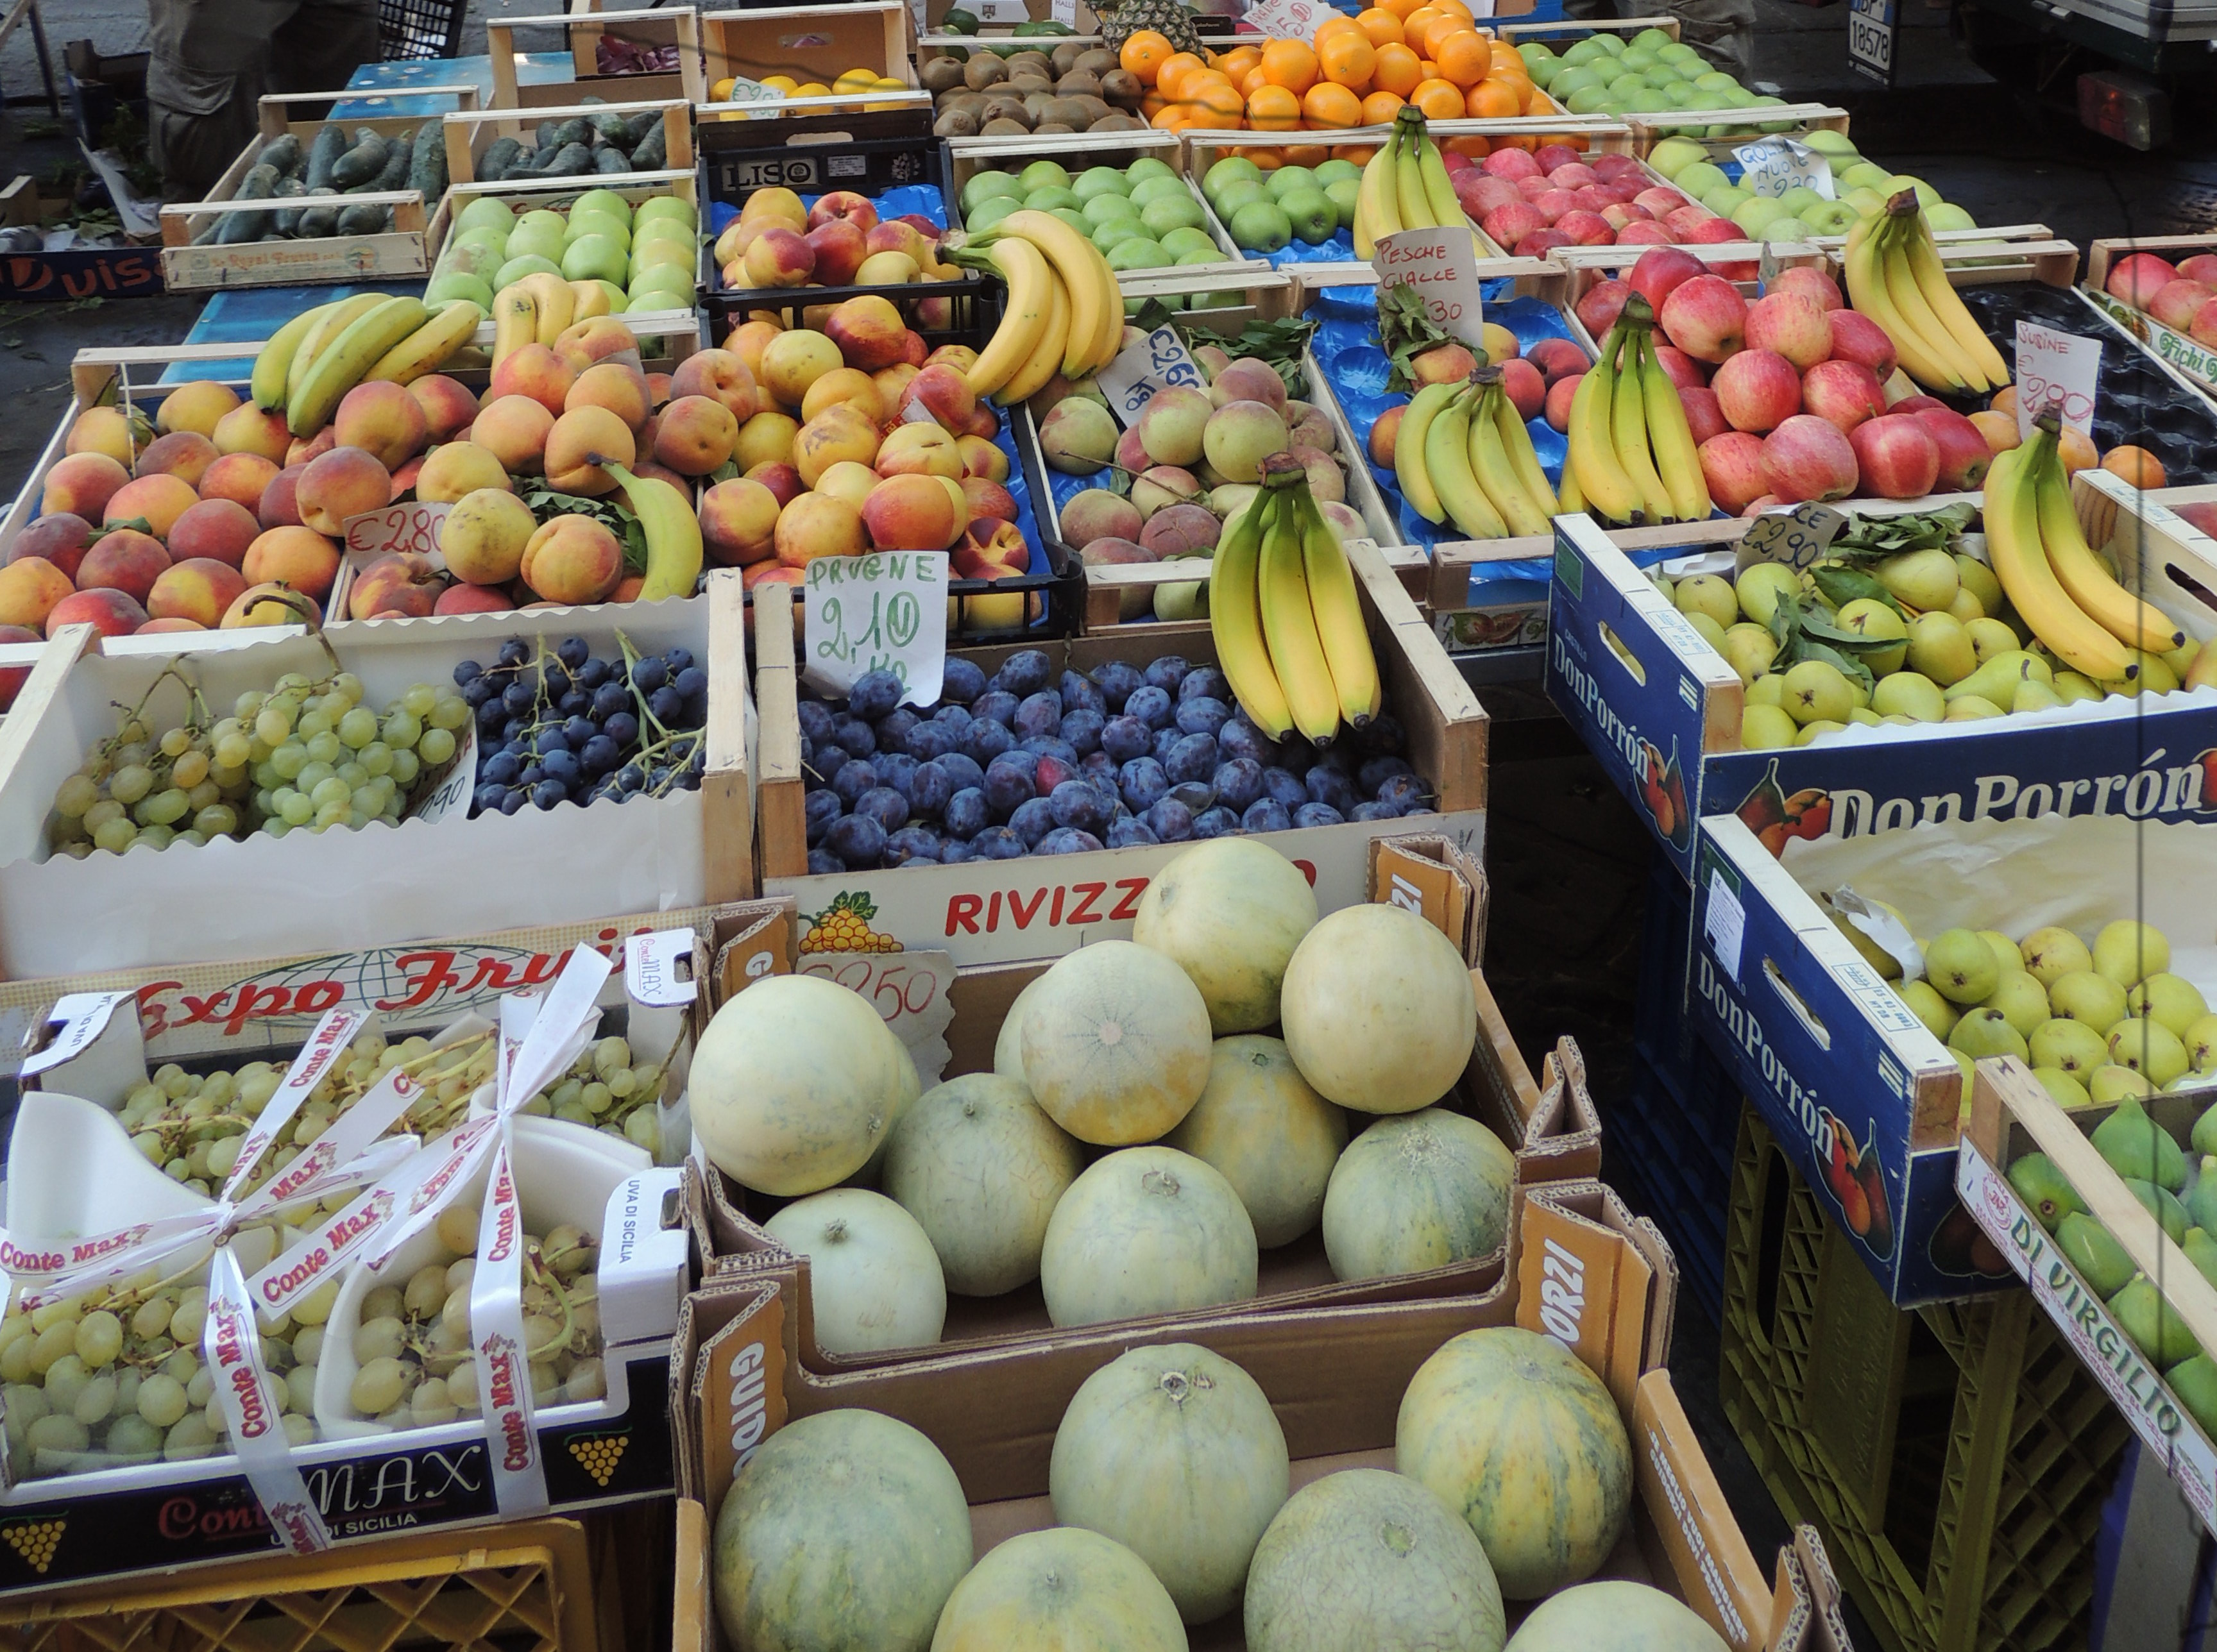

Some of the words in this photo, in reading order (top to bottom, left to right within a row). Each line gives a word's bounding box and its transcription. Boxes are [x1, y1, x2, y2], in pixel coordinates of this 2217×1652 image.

[1853, 20, 1889, 62] 18578
[727, 162, 811, 187] LISO
[1377, 240, 1447, 264] PESCHE
[2017, 354, 2037, 376] €
[1742, 517, 1819, 569] €2,90
[289, 1048, 332, 1088] Conte
[314, 1013, 350, 1045] Max
[269, 1155, 323, 1201] Max
[626, 1179, 640, 1204] UVA
[488, 1206, 514, 1263] Conte
[625, 1206, 638, 1217] DI
[0, 1240, 65, 1271] Conte
[71, 1231, 131, 1263] Max
[263, 1246, 330, 1302] Conte
[325, 1202, 380, 1252] Max
[619, 1220, 636, 1264] SICILIA
[216, 1314, 244, 1368] Max
[2049, 1261, 2182, 1437] VIRGILIO
[232, 1365, 268, 1440] Conte
[489, 1351, 516, 1409] Max
[503, 1409, 528, 1472] Conte
[345, 1512, 419, 1537] SICILIA
